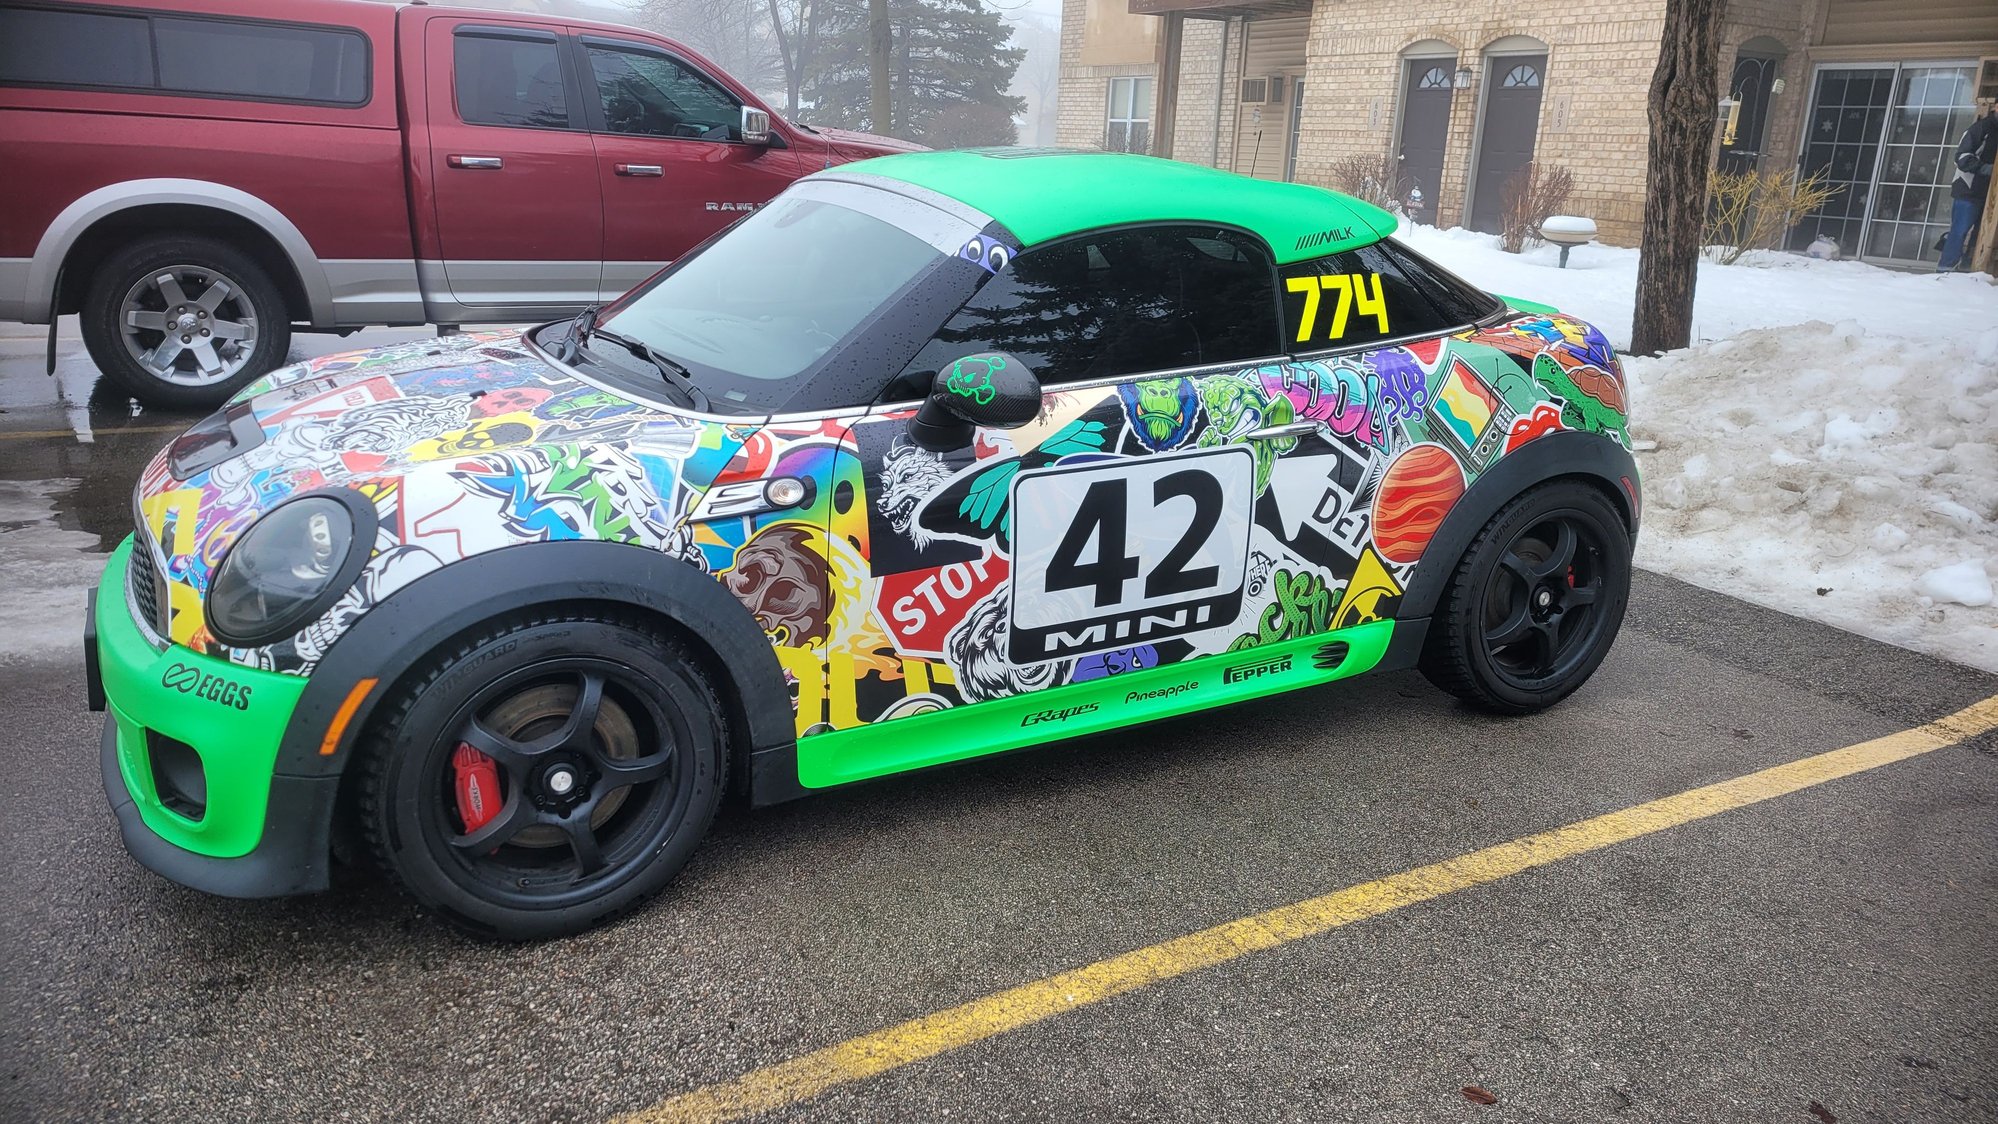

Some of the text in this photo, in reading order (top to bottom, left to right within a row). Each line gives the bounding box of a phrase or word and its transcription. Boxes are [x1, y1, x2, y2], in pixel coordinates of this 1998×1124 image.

[705, 202, 753, 211] RAM
[1286, 273, 1389, 342] 774
[1045, 469, 1224, 608] 42
[892, 545, 993, 635] STOP
[1045, 605, 1211, 651] MINI
[1223, 653, 1293, 685] PEPPER
[195, 674, 252, 711] EGGS
[1125, 680, 1199, 704] Pineapple
